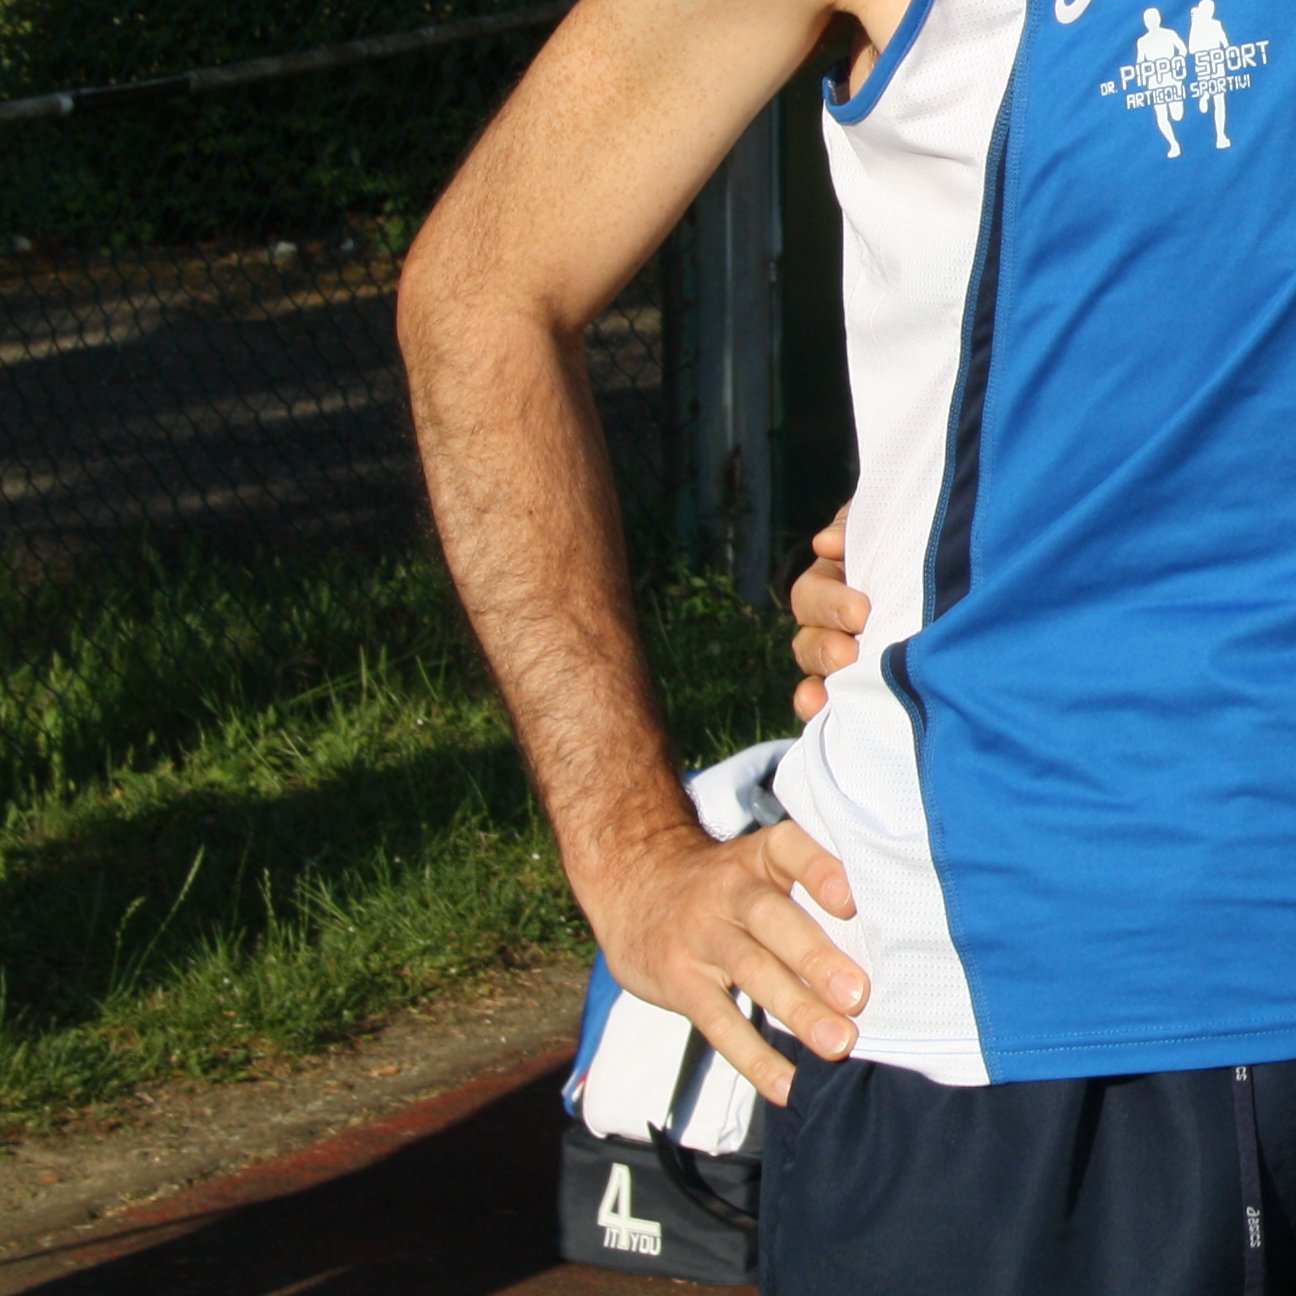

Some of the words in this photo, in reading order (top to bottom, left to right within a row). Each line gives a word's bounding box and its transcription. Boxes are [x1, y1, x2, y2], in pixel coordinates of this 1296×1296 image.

[1100, 81, 1118, 97] DR.
[1119, 56, 1187, 91] PIPPO
[1194, 40, 1270, 80] SPORT
[1126, 85, 1187, 110] ARTICOLI
[1189, 73, 1252, 99] SPORTIVI
